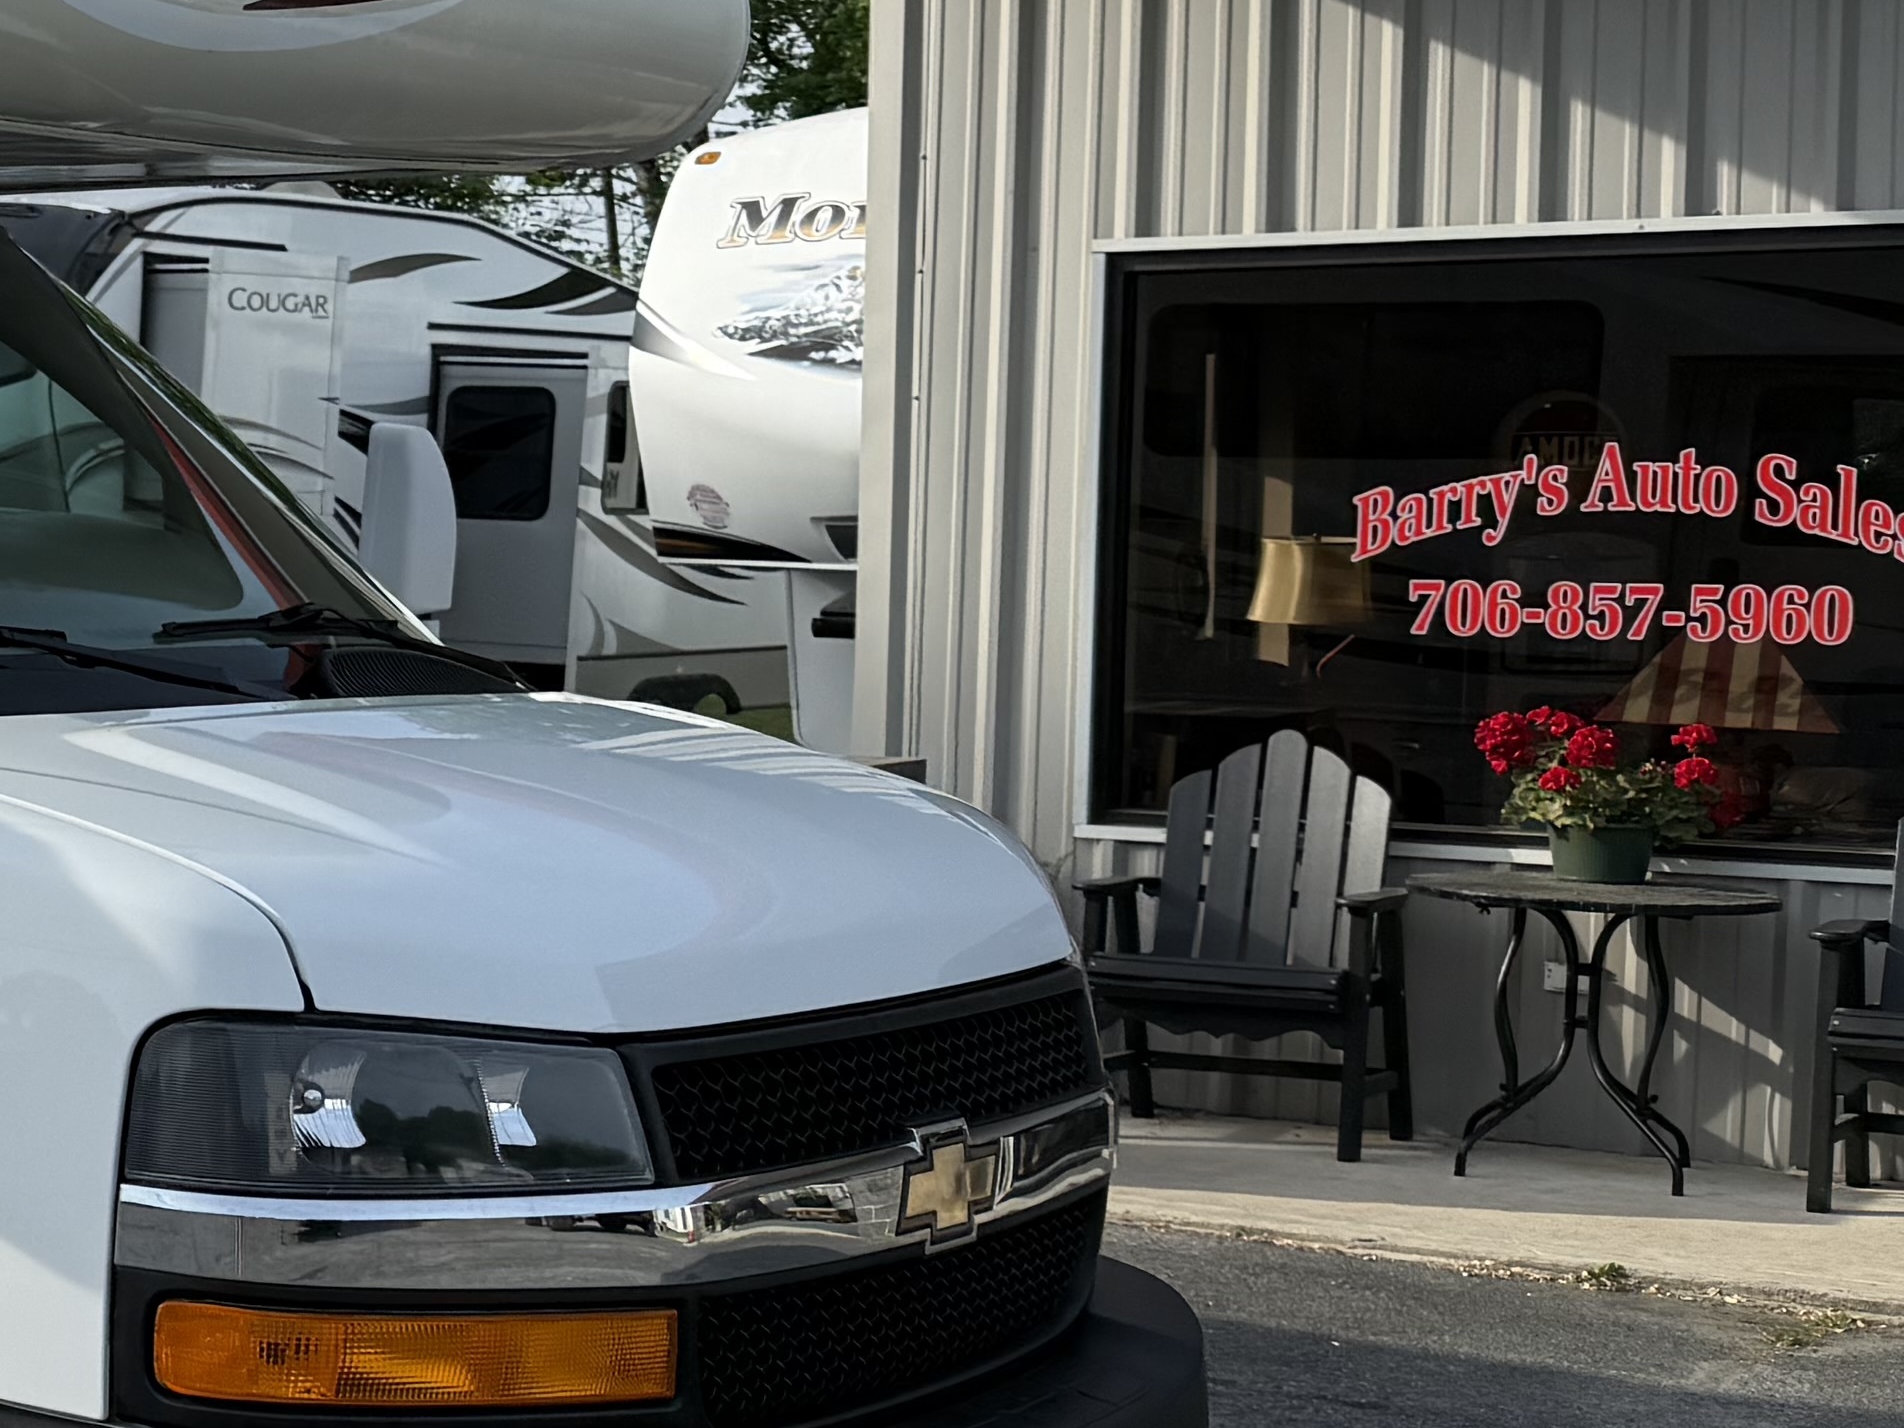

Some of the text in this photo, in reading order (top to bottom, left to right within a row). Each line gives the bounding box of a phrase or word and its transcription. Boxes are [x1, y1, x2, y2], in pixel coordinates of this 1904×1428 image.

[228, 287, 328, 316] COUGAR
[1513, 435, 1620, 467] AMOC
[1350, 456, 1569, 562] Barry's
[1582, 442, 1738, 519] Auto
[1409, 580, 1853, 647] 706-857-5960
